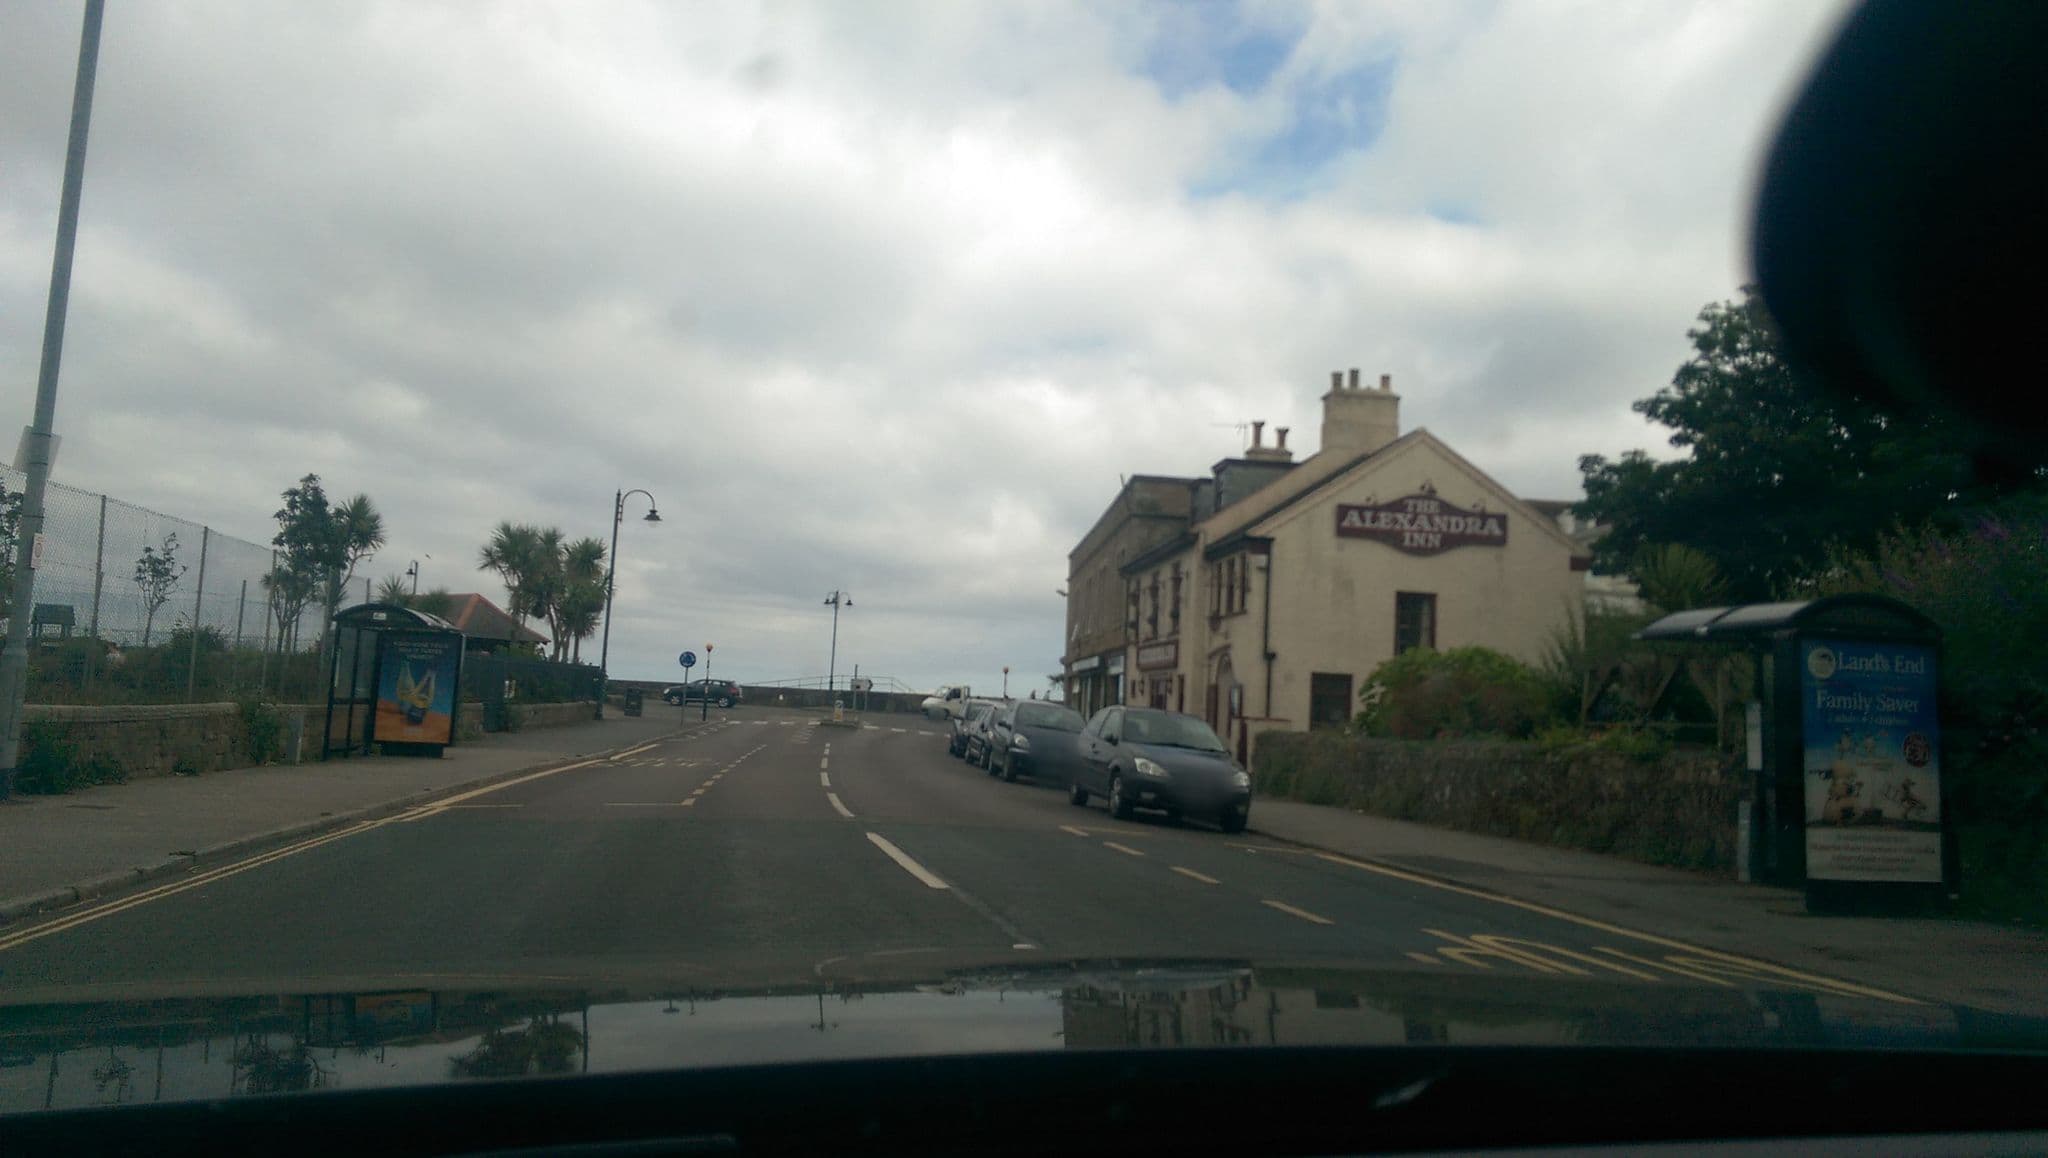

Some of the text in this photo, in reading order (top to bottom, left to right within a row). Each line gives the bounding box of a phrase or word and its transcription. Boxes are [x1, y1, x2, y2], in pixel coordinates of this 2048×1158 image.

[1404, 499, 1441, 514] THE
[1341, 509, 1504, 536] ALEXANDRA
[1402, 532, 1442, 548] INN
[1838, 651, 1925, 675] Land's End
[1815, 688, 1920, 713] Family Saver
